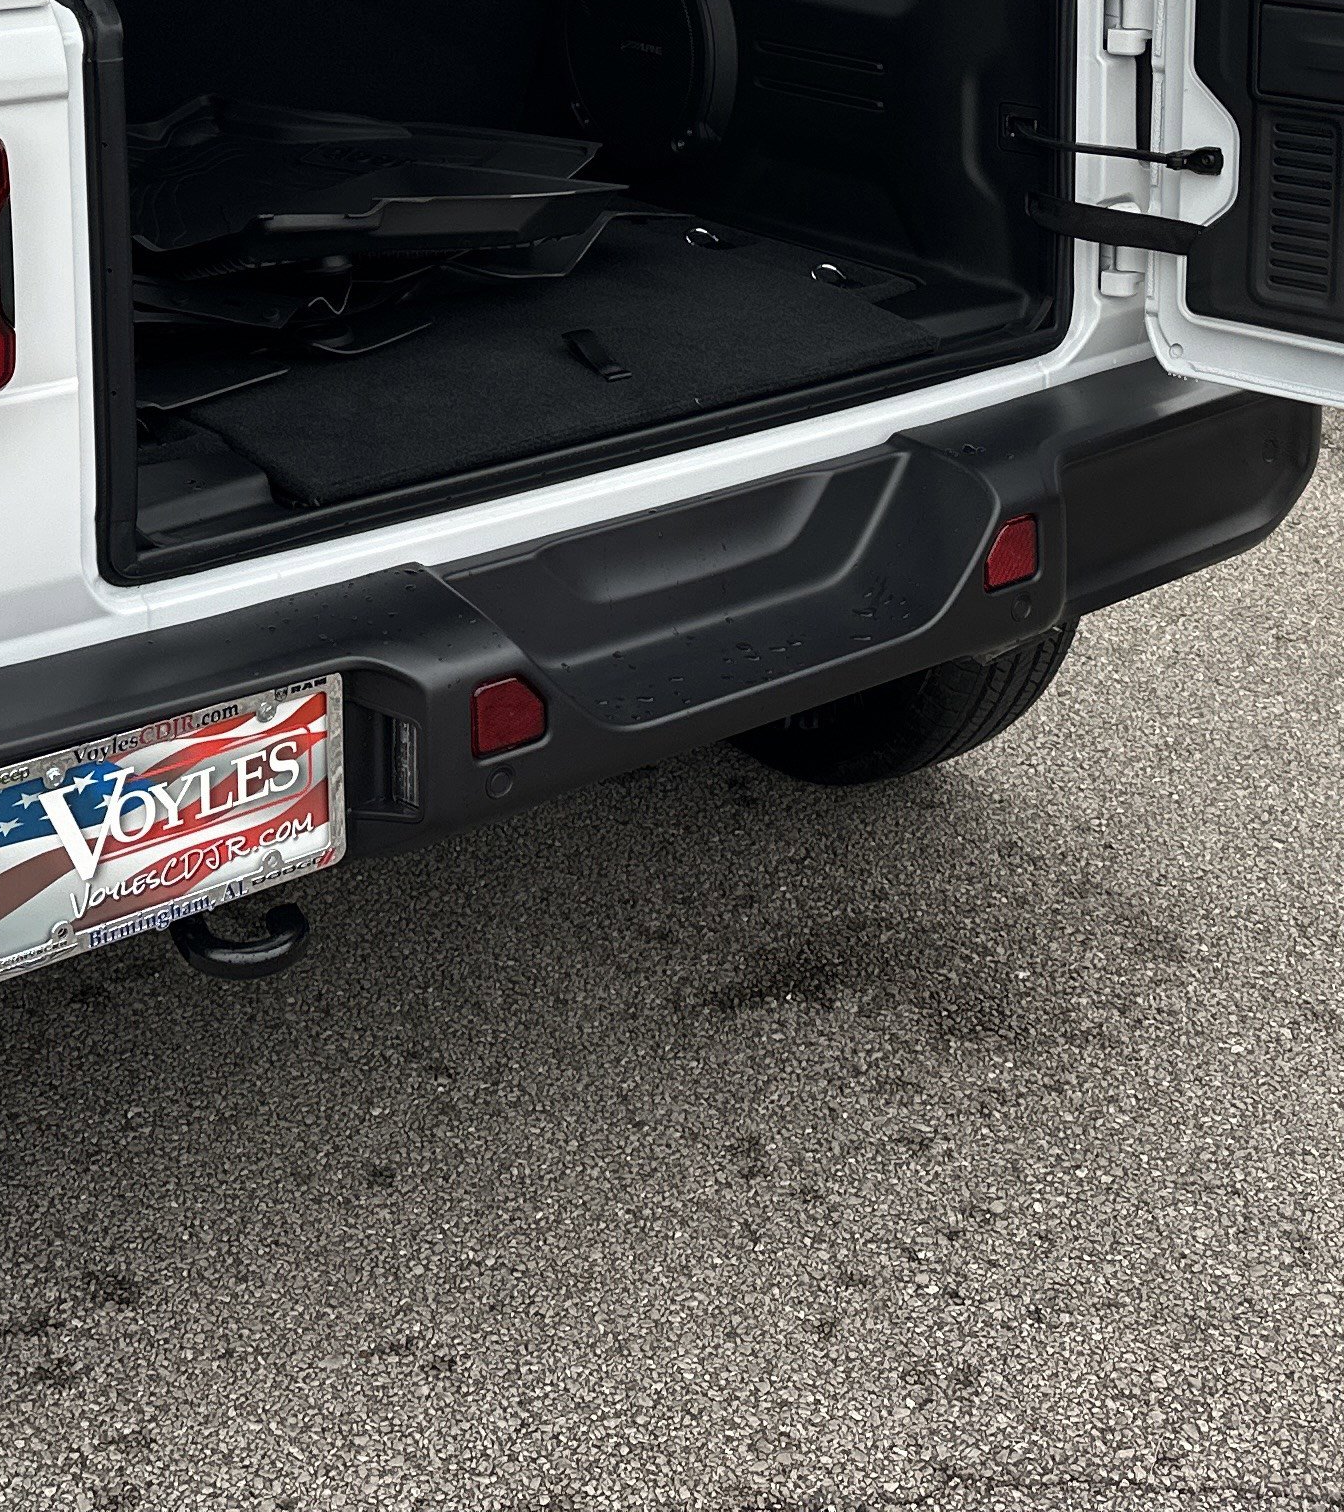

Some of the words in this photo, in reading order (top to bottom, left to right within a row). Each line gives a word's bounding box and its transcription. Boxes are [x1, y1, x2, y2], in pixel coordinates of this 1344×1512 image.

[291, 676, 327, 694] RAM
[73, 703, 240, 765] VoylesCDJR.com
[38, 740, 301, 882] VOYLES
[88, 894, 216, 949] Birmingham,
[221, 879, 249, 902] AL
